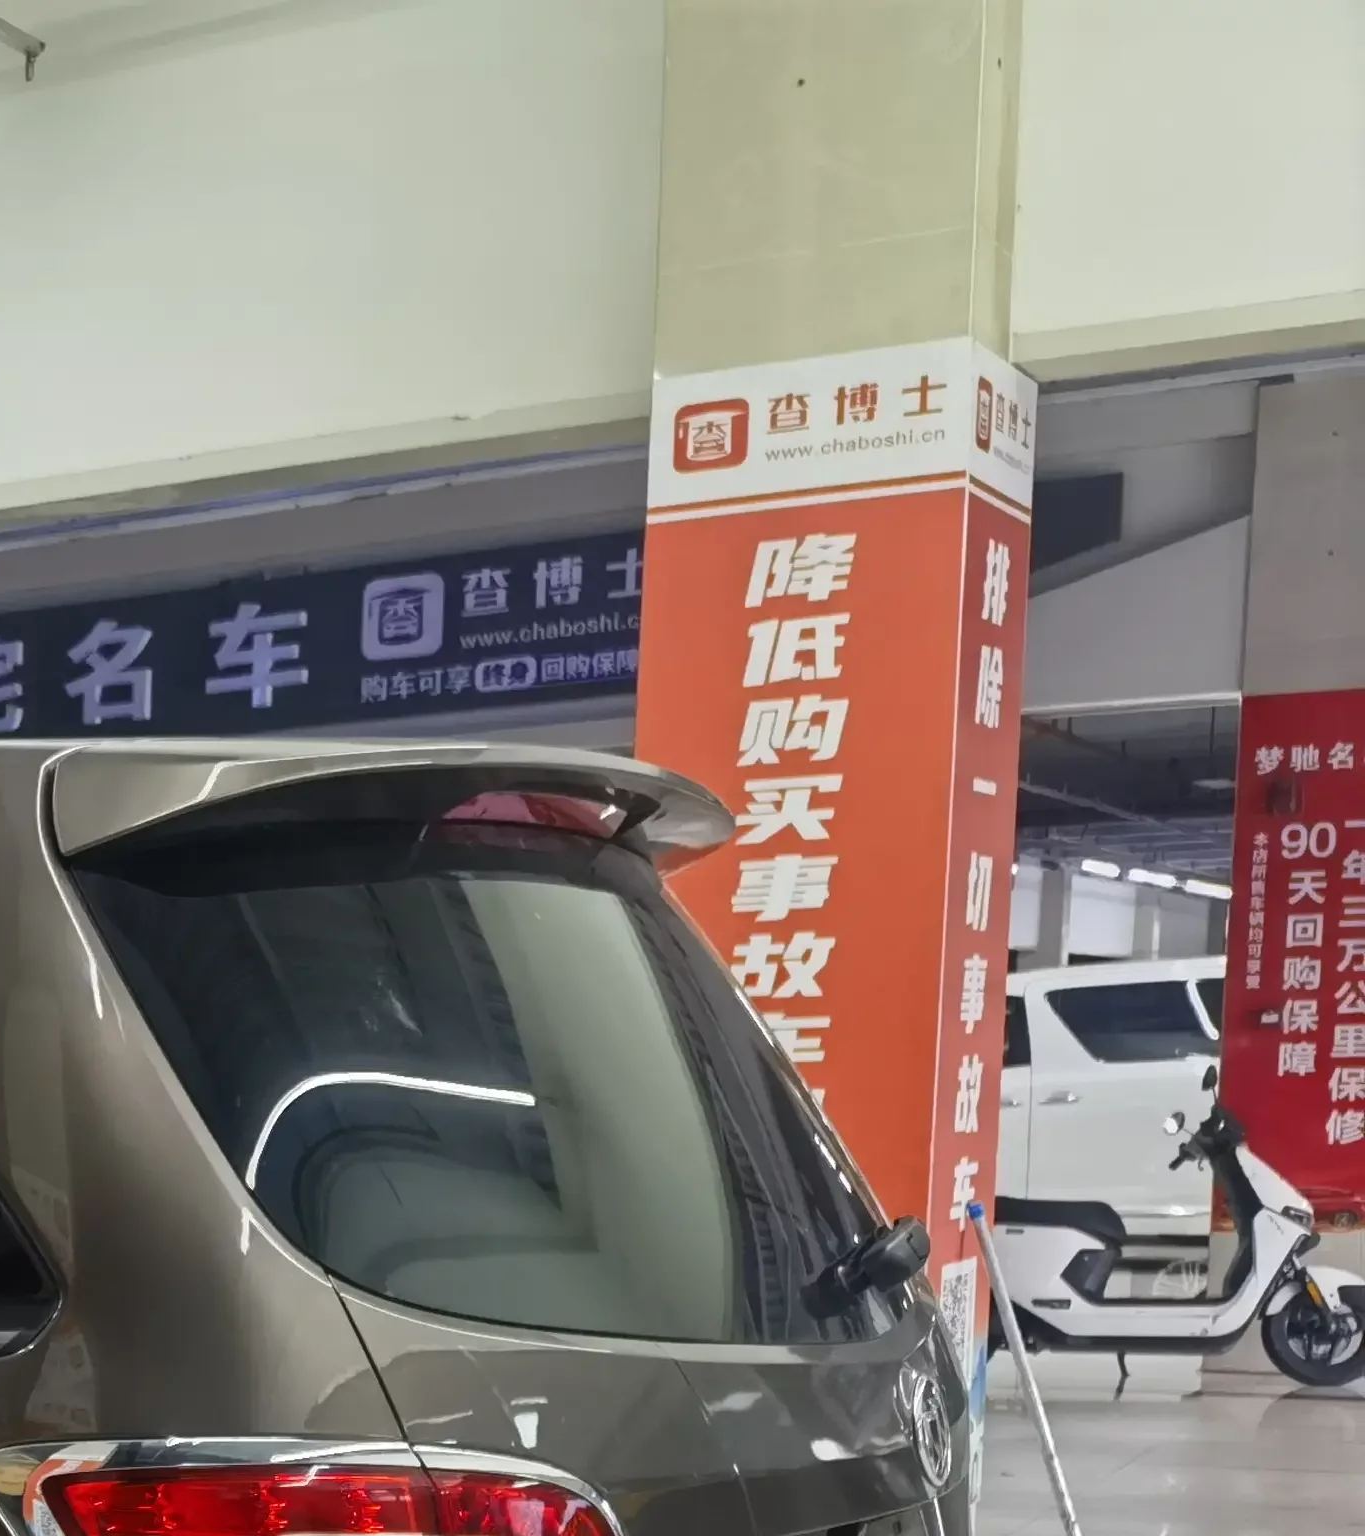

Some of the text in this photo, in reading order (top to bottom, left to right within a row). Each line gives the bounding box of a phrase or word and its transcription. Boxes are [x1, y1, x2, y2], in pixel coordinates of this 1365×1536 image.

[766, 374, 947, 436] 查博士
[765, 428, 946, 463] www.chaboshi.cn
[461, 548, 642, 617] 查博士
[1255, 740, 1365, 775] 梦驰名
[731, 532, 857, 1105] 降低购买事故车
[1277, 822, 1337, 1077] 90天回购保障
